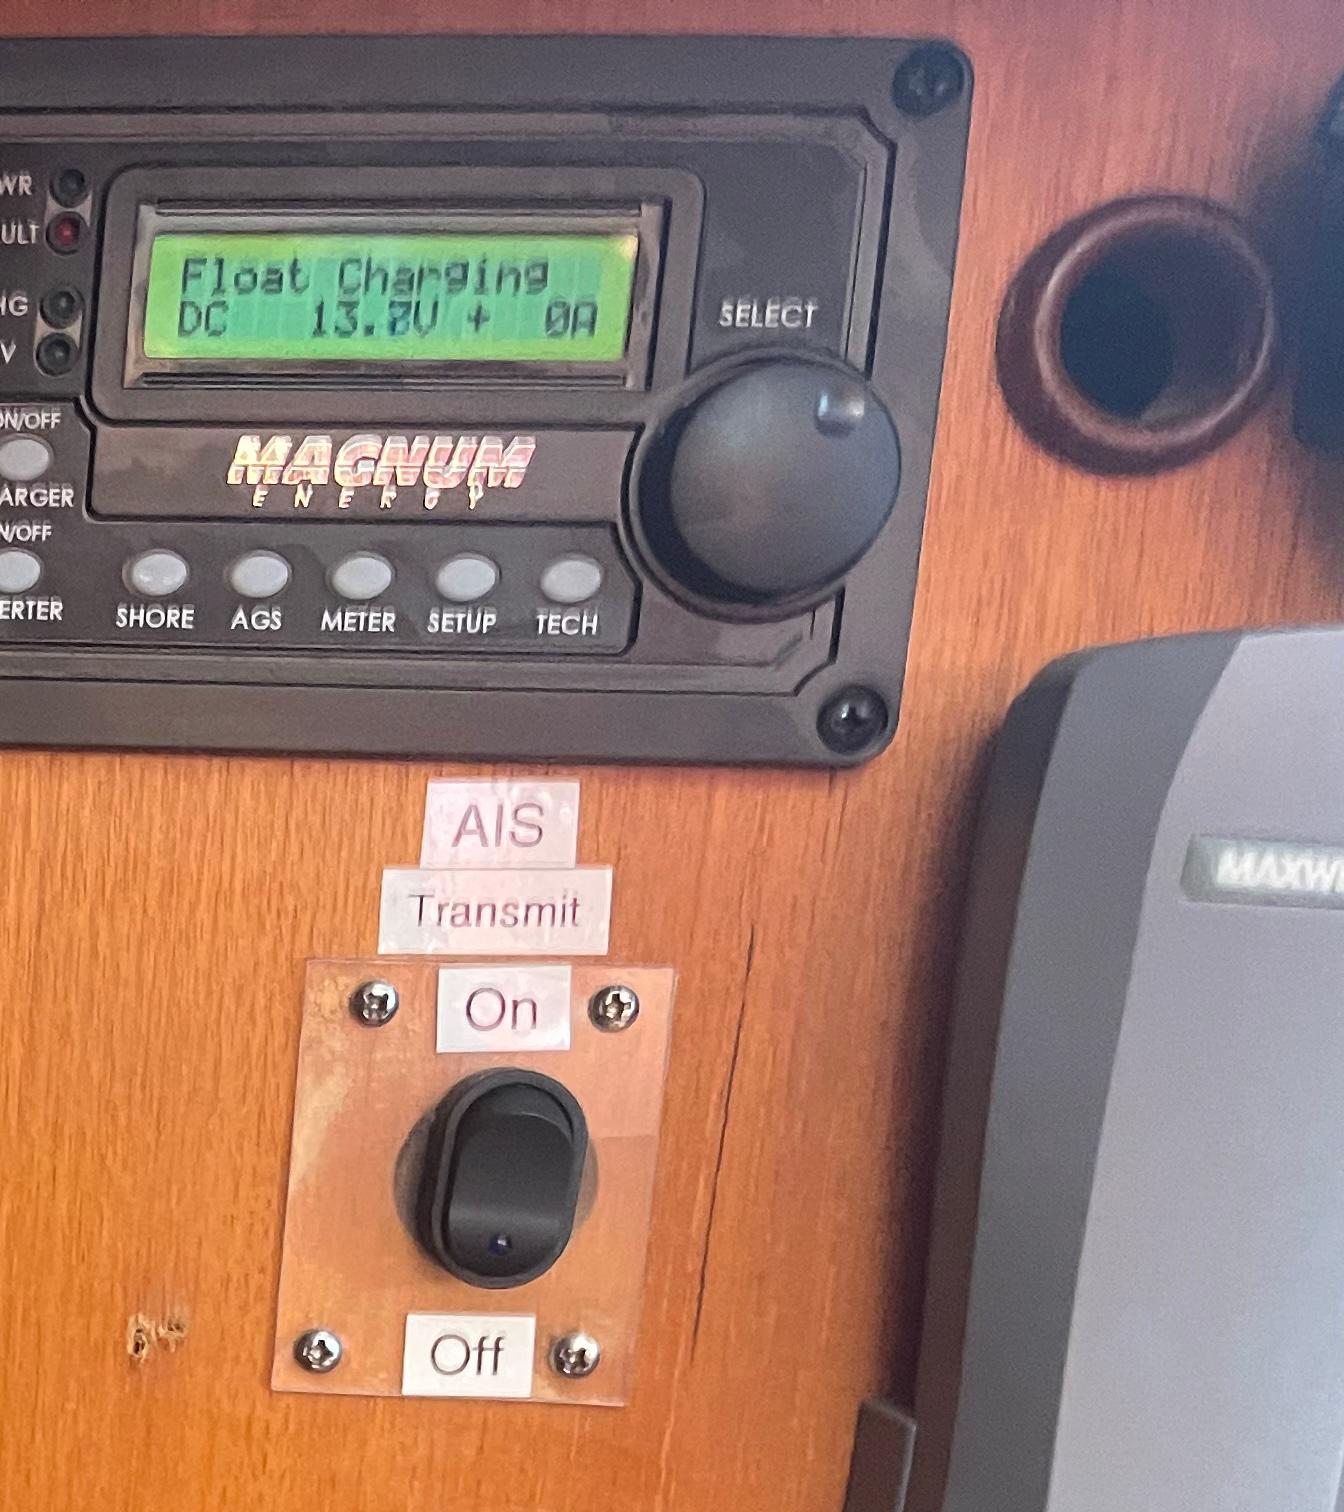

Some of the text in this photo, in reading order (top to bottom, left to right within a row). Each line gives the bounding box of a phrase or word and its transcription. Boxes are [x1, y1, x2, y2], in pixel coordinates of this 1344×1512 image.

[181, 256, 550, 296] Float Charging
[178, 300, 229, 338] DC
[719, 297, 820, 328] SELECT
[226, 434, 538, 488] MAGNUM
[251, 486, 485, 511] ENERGY
[115, 604, 195, 631] SHORE
[230, 606, 283, 632] AGS
[320, 606, 397, 634] METER
[427, 607, 499, 636] SETUP
[535, 608, 599, 637] TECH
[450, 803, 545, 849] AIS
[410, 893, 581, 930] Transmit
[465, 986, 539, 1032] On
[430, 1334, 505, 1377] Off
